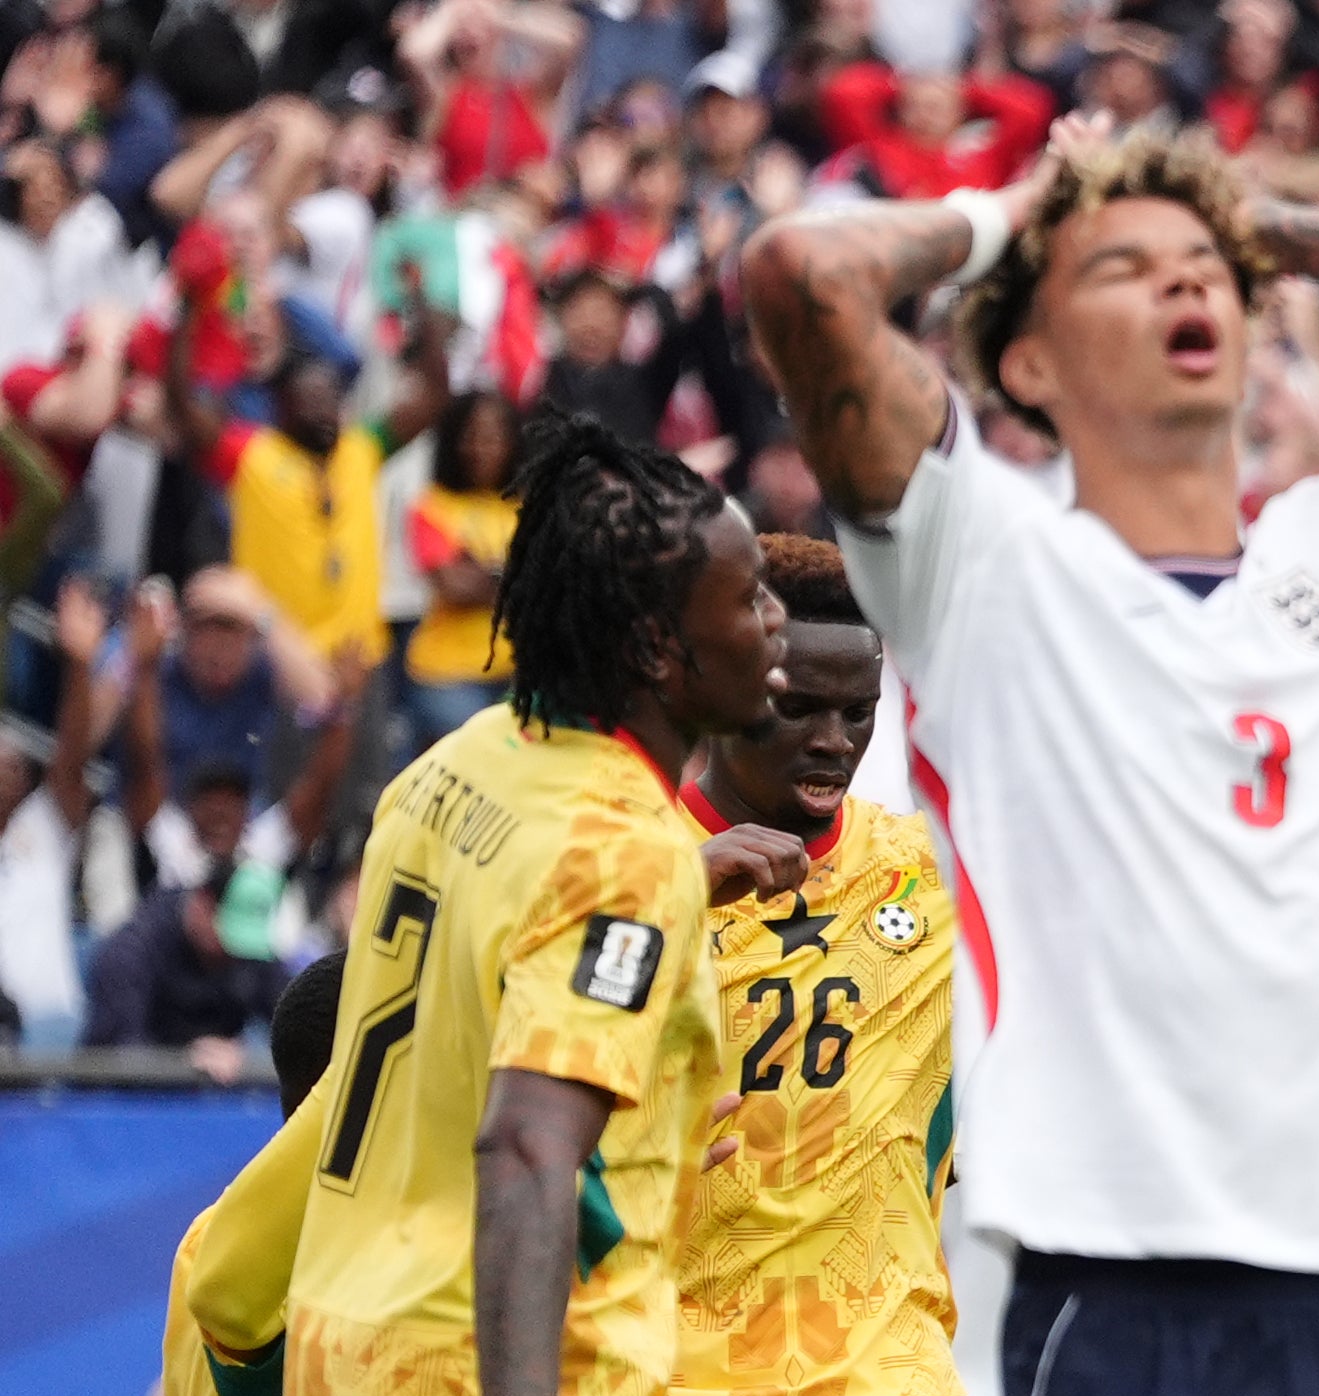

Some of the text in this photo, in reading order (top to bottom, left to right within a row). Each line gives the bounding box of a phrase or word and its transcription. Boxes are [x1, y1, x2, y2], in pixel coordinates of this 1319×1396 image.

[1232, 710, 1291, 828] 3
[317, 867, 441, 1197] 7
[740, 976, 861, 1096] 26
